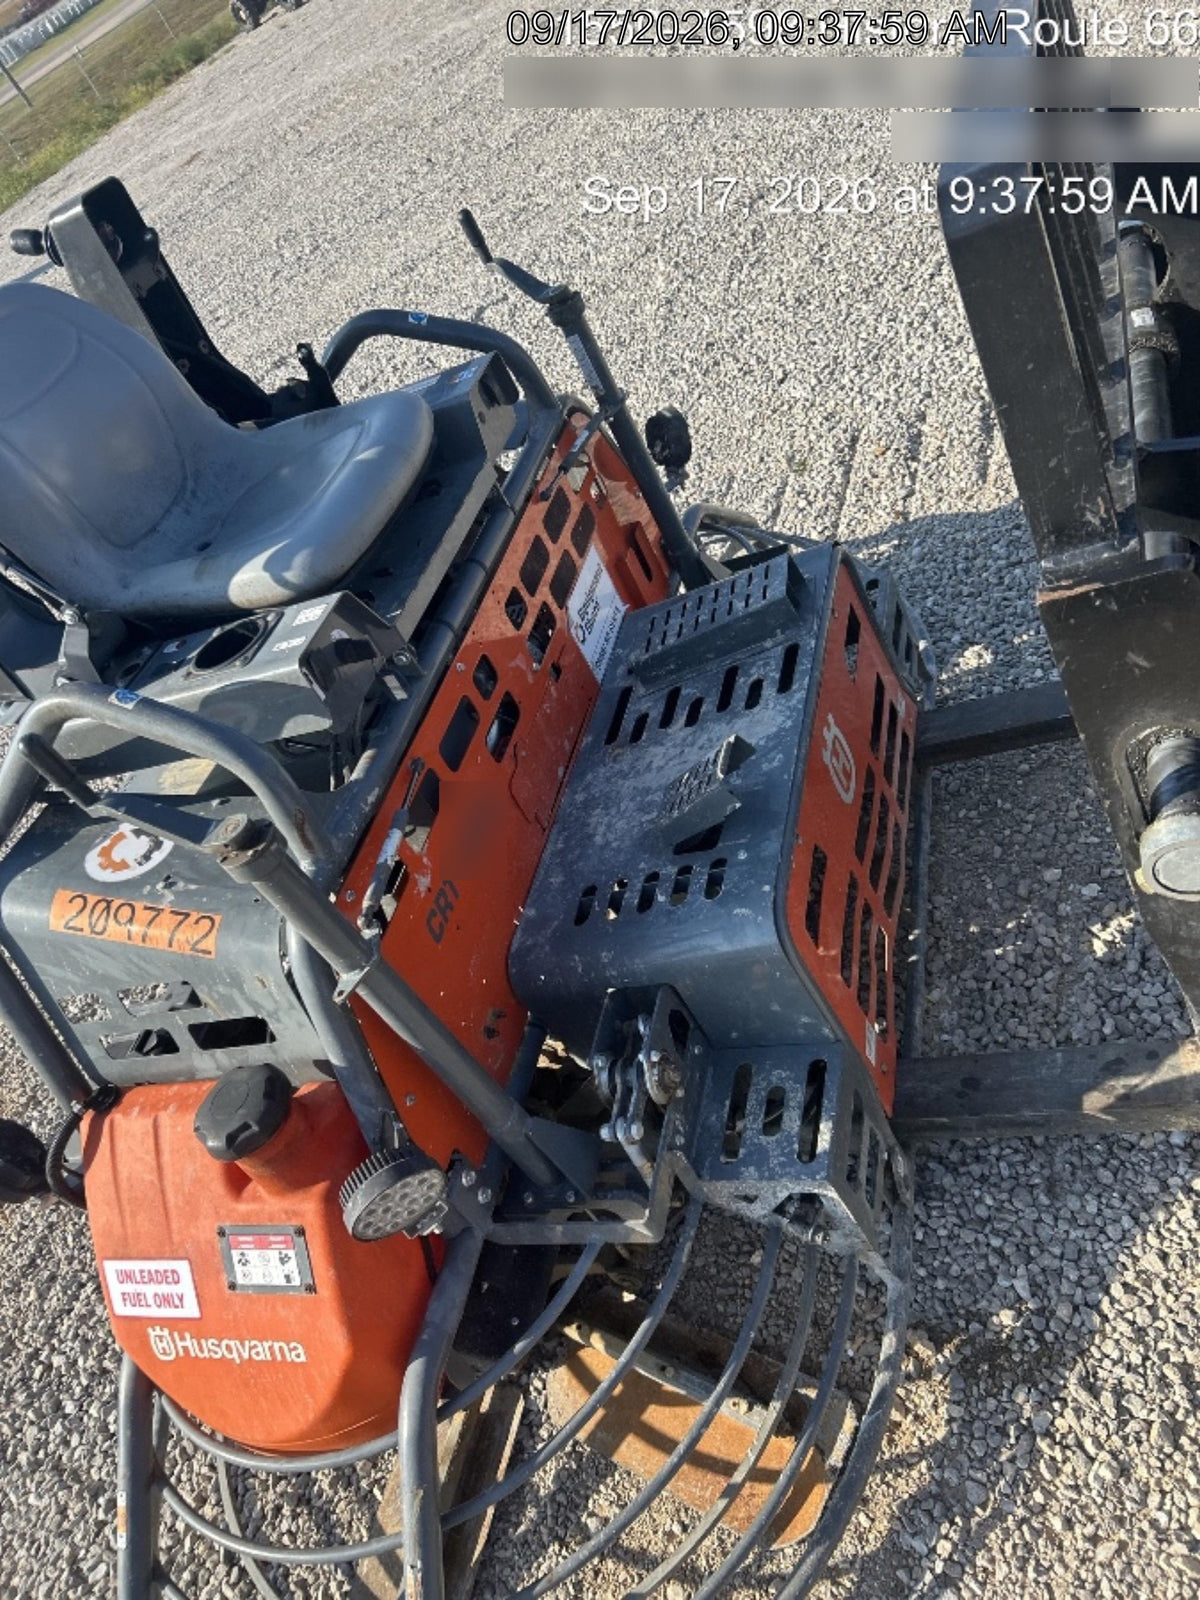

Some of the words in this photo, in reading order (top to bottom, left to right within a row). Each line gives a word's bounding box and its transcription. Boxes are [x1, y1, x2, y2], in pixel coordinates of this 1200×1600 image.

[63, 893, 216, 956] 209772
[115, 1268, 181, 1286] UNLEADED
[120, 1291, 152, 1308] FUEL
[153, 1291, 184, 1309] ONLY
[173, 1330, 308, 1365] Husqvarna
